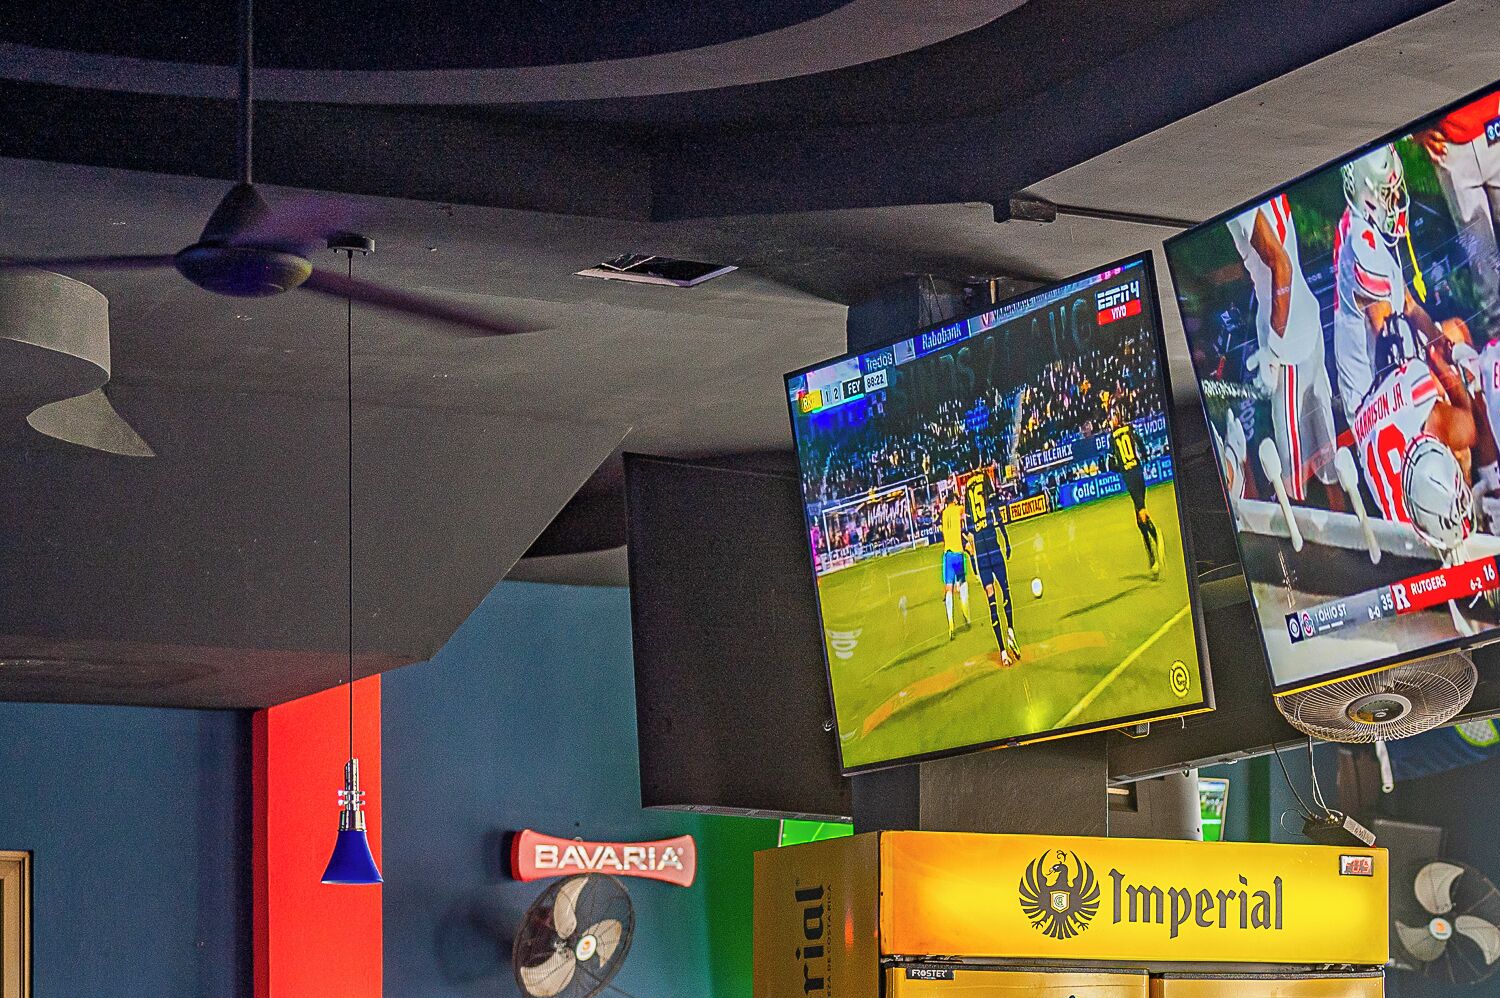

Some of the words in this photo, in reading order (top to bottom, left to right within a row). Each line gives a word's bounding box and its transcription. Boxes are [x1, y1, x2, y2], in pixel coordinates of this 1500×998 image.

[1110, 305, 1127, 320] VIVO
[922, 323, 962, 350] Rabobank
[847, 381, 861, 395] FEY
[866, 373, 885, 389] 88:22
[1354, 391, 1391, 445] HARRISON
[1392, 383, 1408, 412] JR.
[1115, 435, 1137, 463] 10
[1367, 423, 1412, 524] 18
[968, 485, 987, 522] 15
[1319, 606, 1338, 623] OHIO
[1381, 593, 1394, 611] 35
[1392, 583, 1411, 611] R
[1410, 574, 1447, 596] RUTGERS
[1469, 577, 1483, 591] 6-2
[1483, 564, 1496, 582] 16
[535, 844, 684, 871] BAVARIA
[1108, 868, 1283, 940] Imperial
[911, 969, 945, 978] FROSTER
